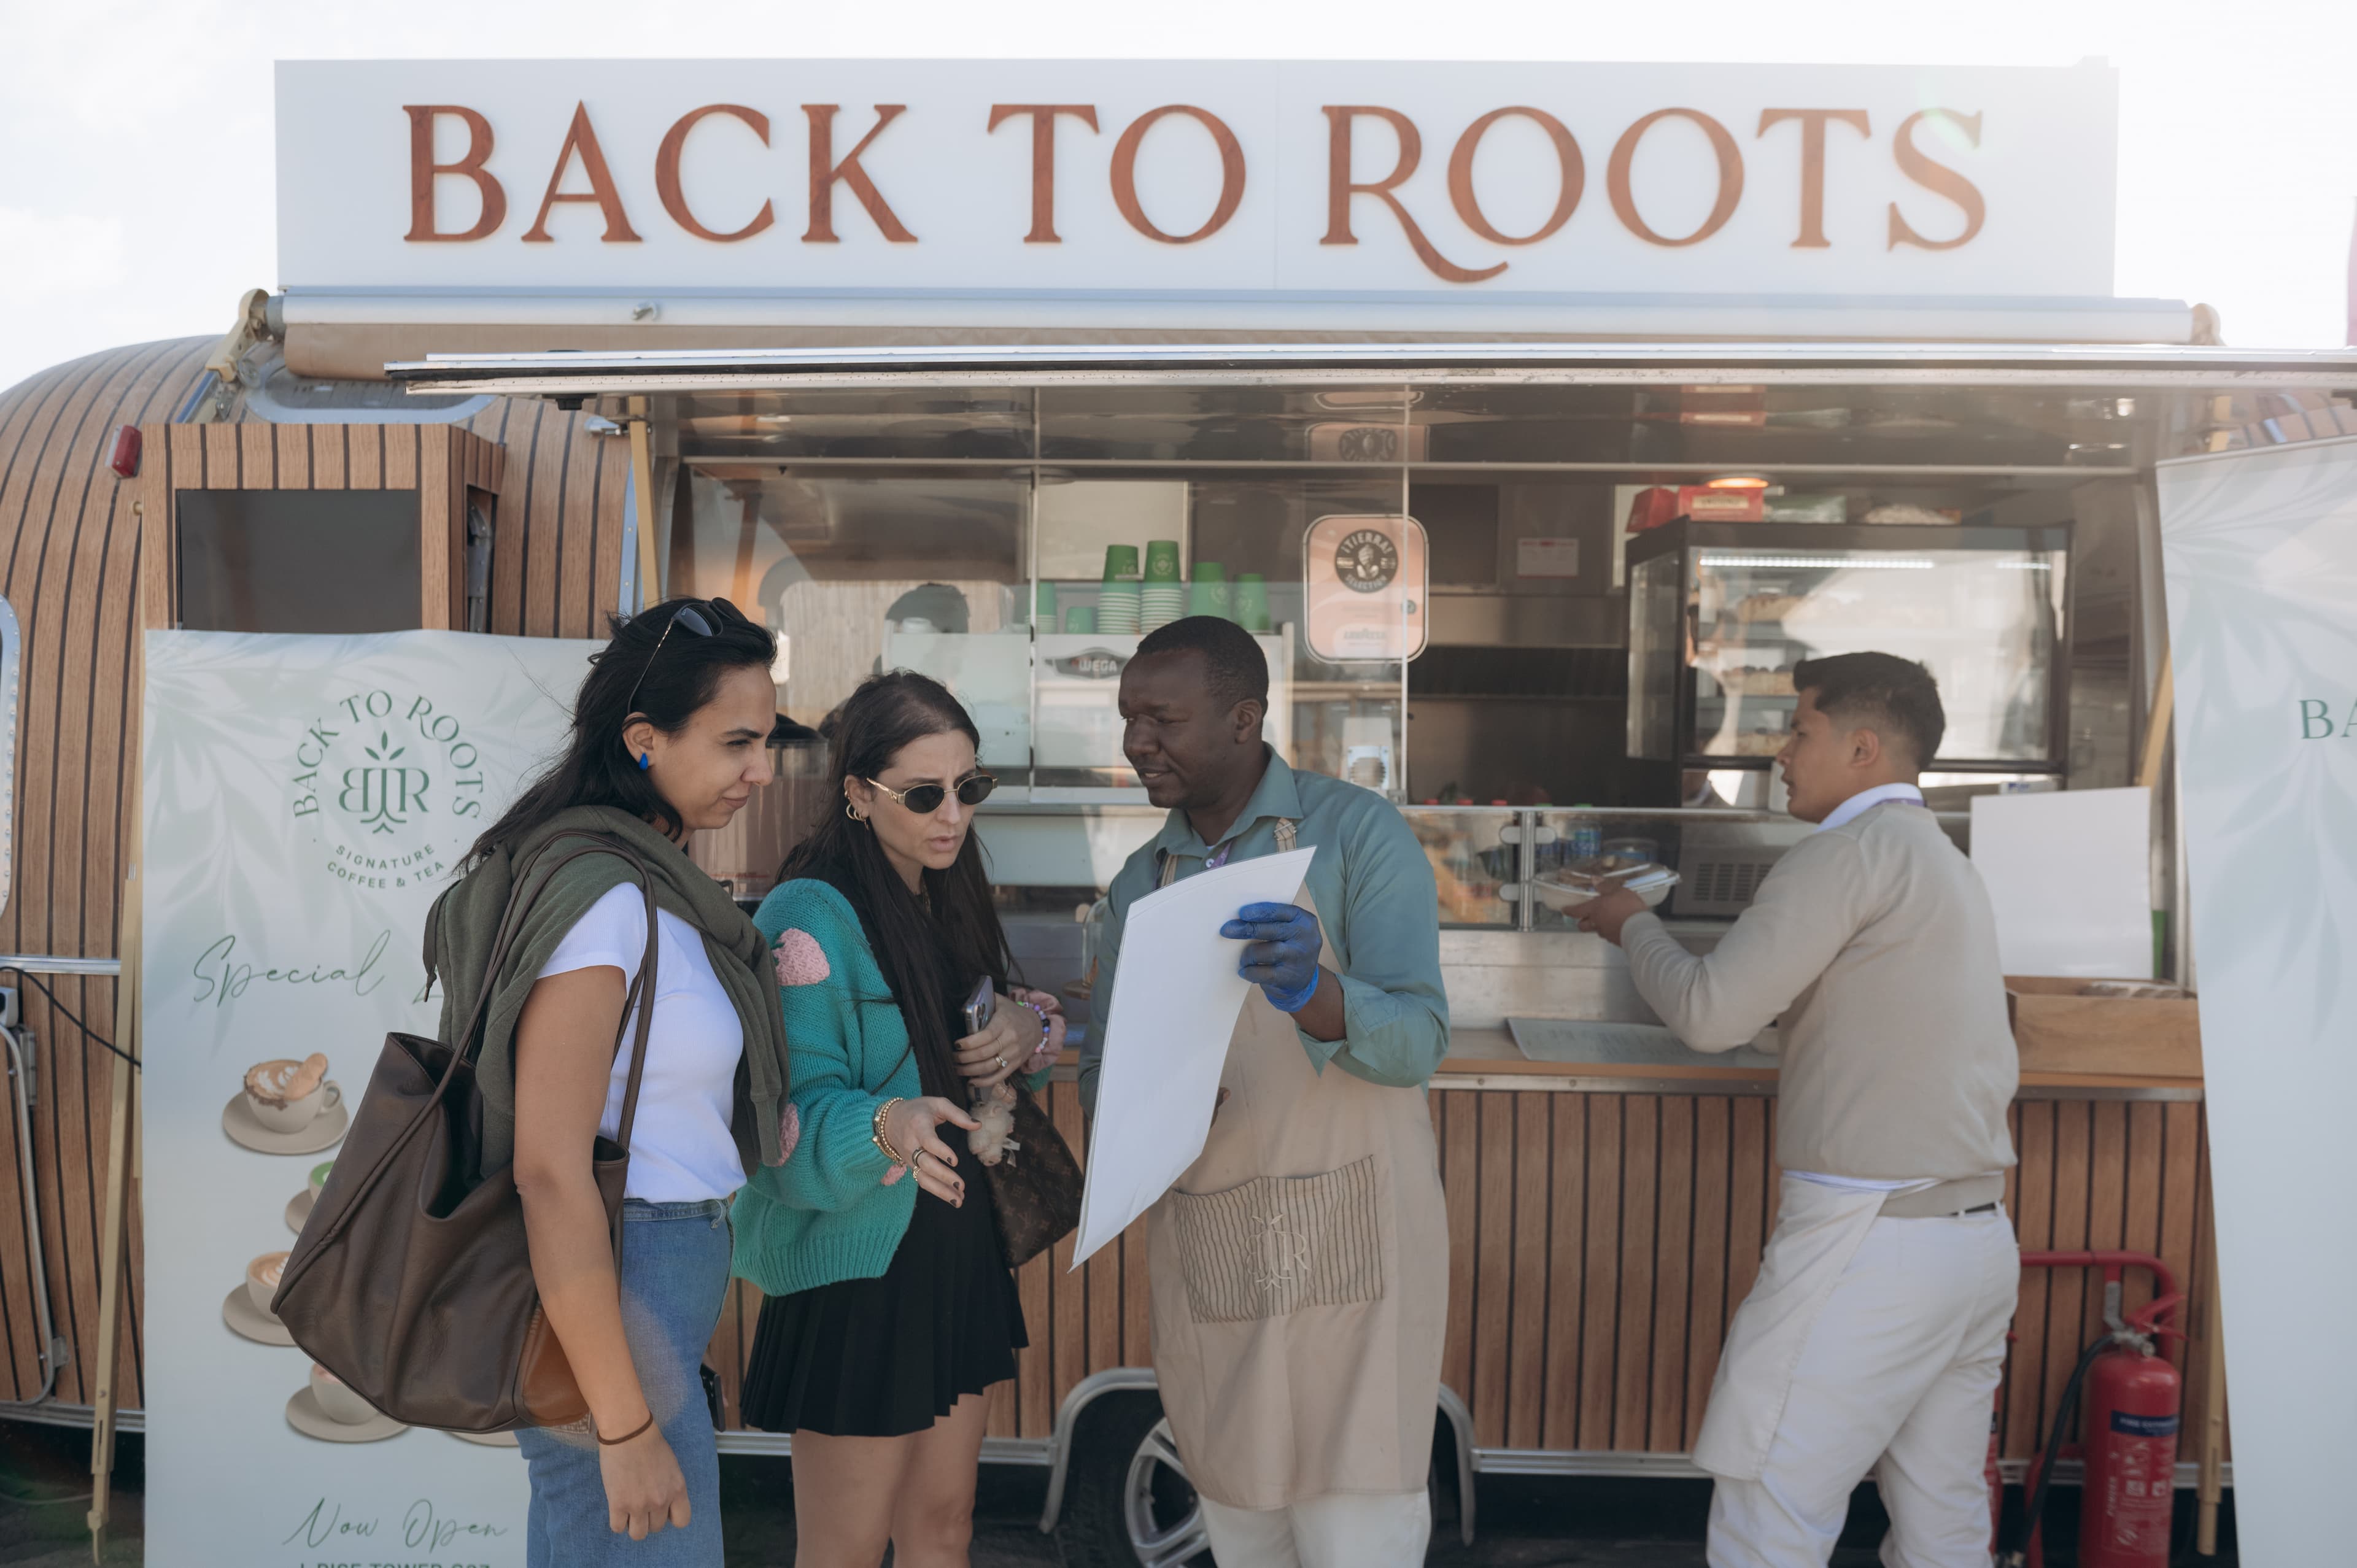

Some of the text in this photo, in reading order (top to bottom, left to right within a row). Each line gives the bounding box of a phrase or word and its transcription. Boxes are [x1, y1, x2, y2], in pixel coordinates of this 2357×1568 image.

[401, 99, 1987, 284] BACK TO ROOTS
[1078, 658, 1118, 672] WEGA
[292, 689, 484, 819] BACK TO ROOTS
[327, 860, 445, 889] COFFEE & TEA
[336, 843, 435, 870] SIGNATURE
[193, 929, 391, 1008] Special
[281, 1497, 508, 1554] Now Open
